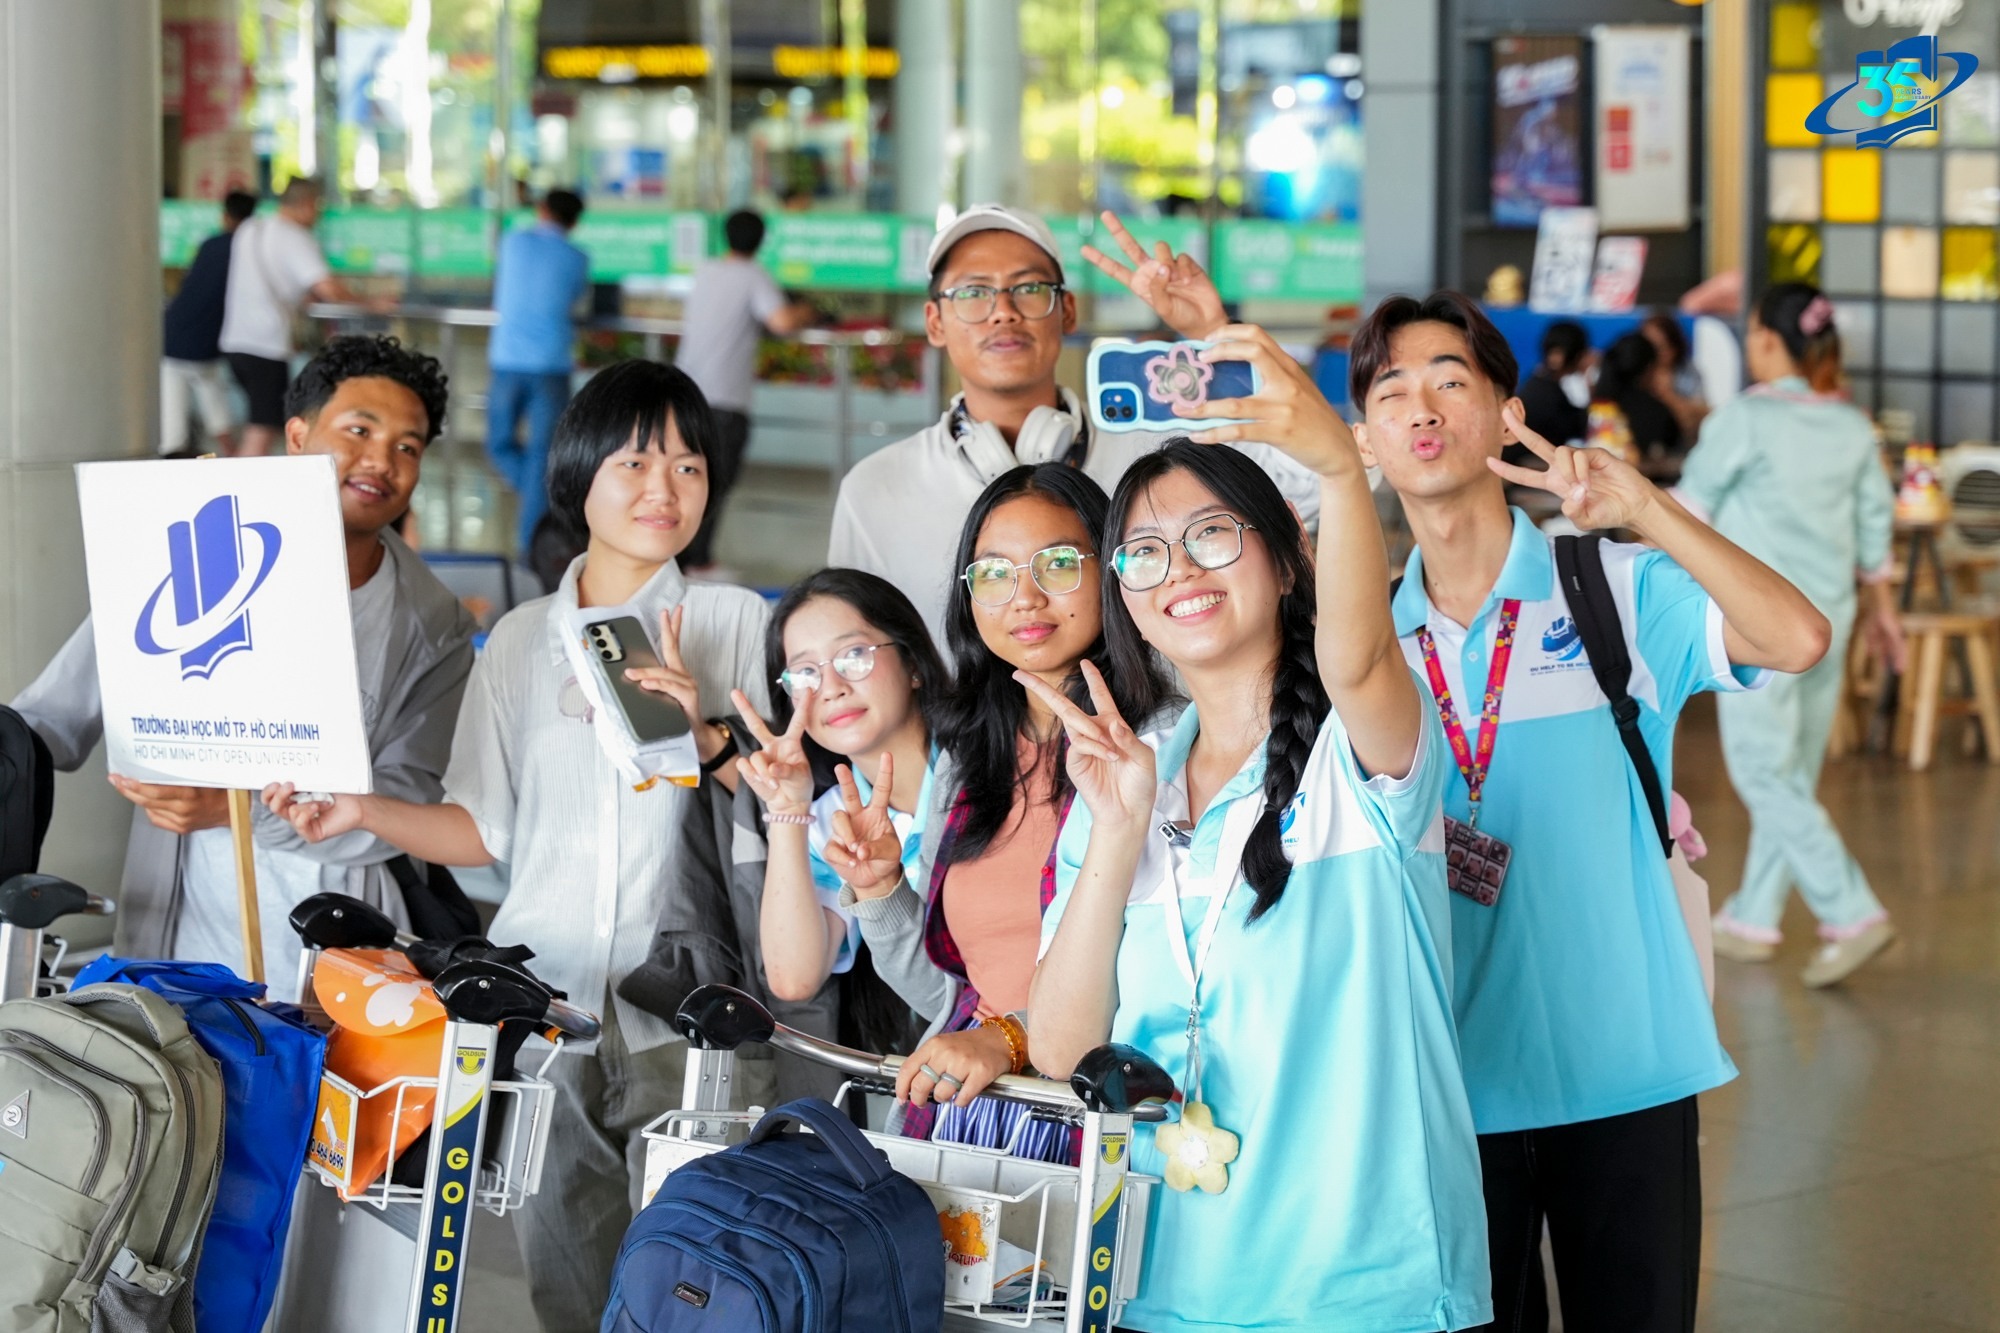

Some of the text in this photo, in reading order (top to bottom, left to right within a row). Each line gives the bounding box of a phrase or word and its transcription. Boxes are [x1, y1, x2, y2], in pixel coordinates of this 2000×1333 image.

[173, 718, 189, 740] ĐẠI
[191, 720, 212, 741] HỌC
[233, 721, 248, 738] TP.
[269, 719, 288, 740] CHÍ
[290, 723, 320, 740] MINH
[134, 745, 320, 767] HO CHI MINH CITY OPEN UNIVERSITY
[317, 1141, 328, 1161] 464
[329, 1149, 344, 1170] 6699
